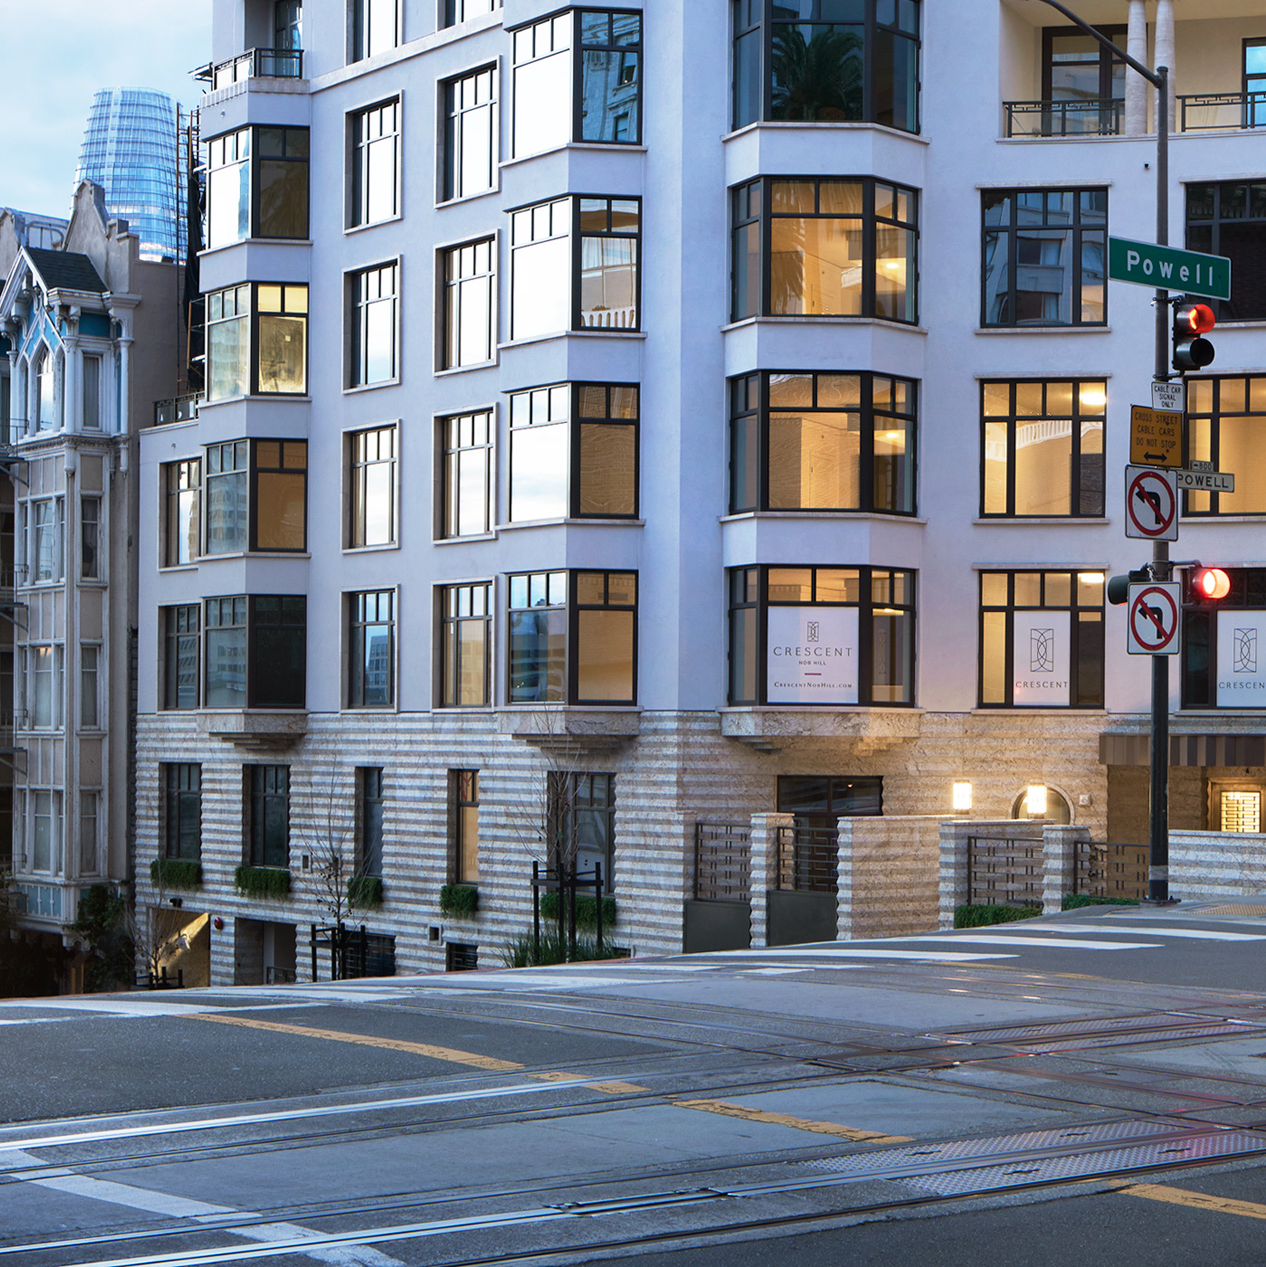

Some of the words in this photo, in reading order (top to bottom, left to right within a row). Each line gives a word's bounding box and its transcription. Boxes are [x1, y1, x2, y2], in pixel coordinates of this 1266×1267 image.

[1127, 250, 1213, 286] Powell
[1154, 385, 1169, 393] CABLE
[1159, 393, 1176, 401] SIGNAL
[1135, 412, 1152, 422] CROSS
[1156, 415, 1178, 425] STREET
[1137, 425, 1155, 435] CABLE
[1159, 428, 1175, 437] CARS
[1136, 437, 1144, 446] DO
[1146, 439, 1157, 447] NOT
[1161, 440, 1176, 449] STOP
[1200, 462, 1212, 470] 800
[773, 647, 852, 656] CRESCENT
